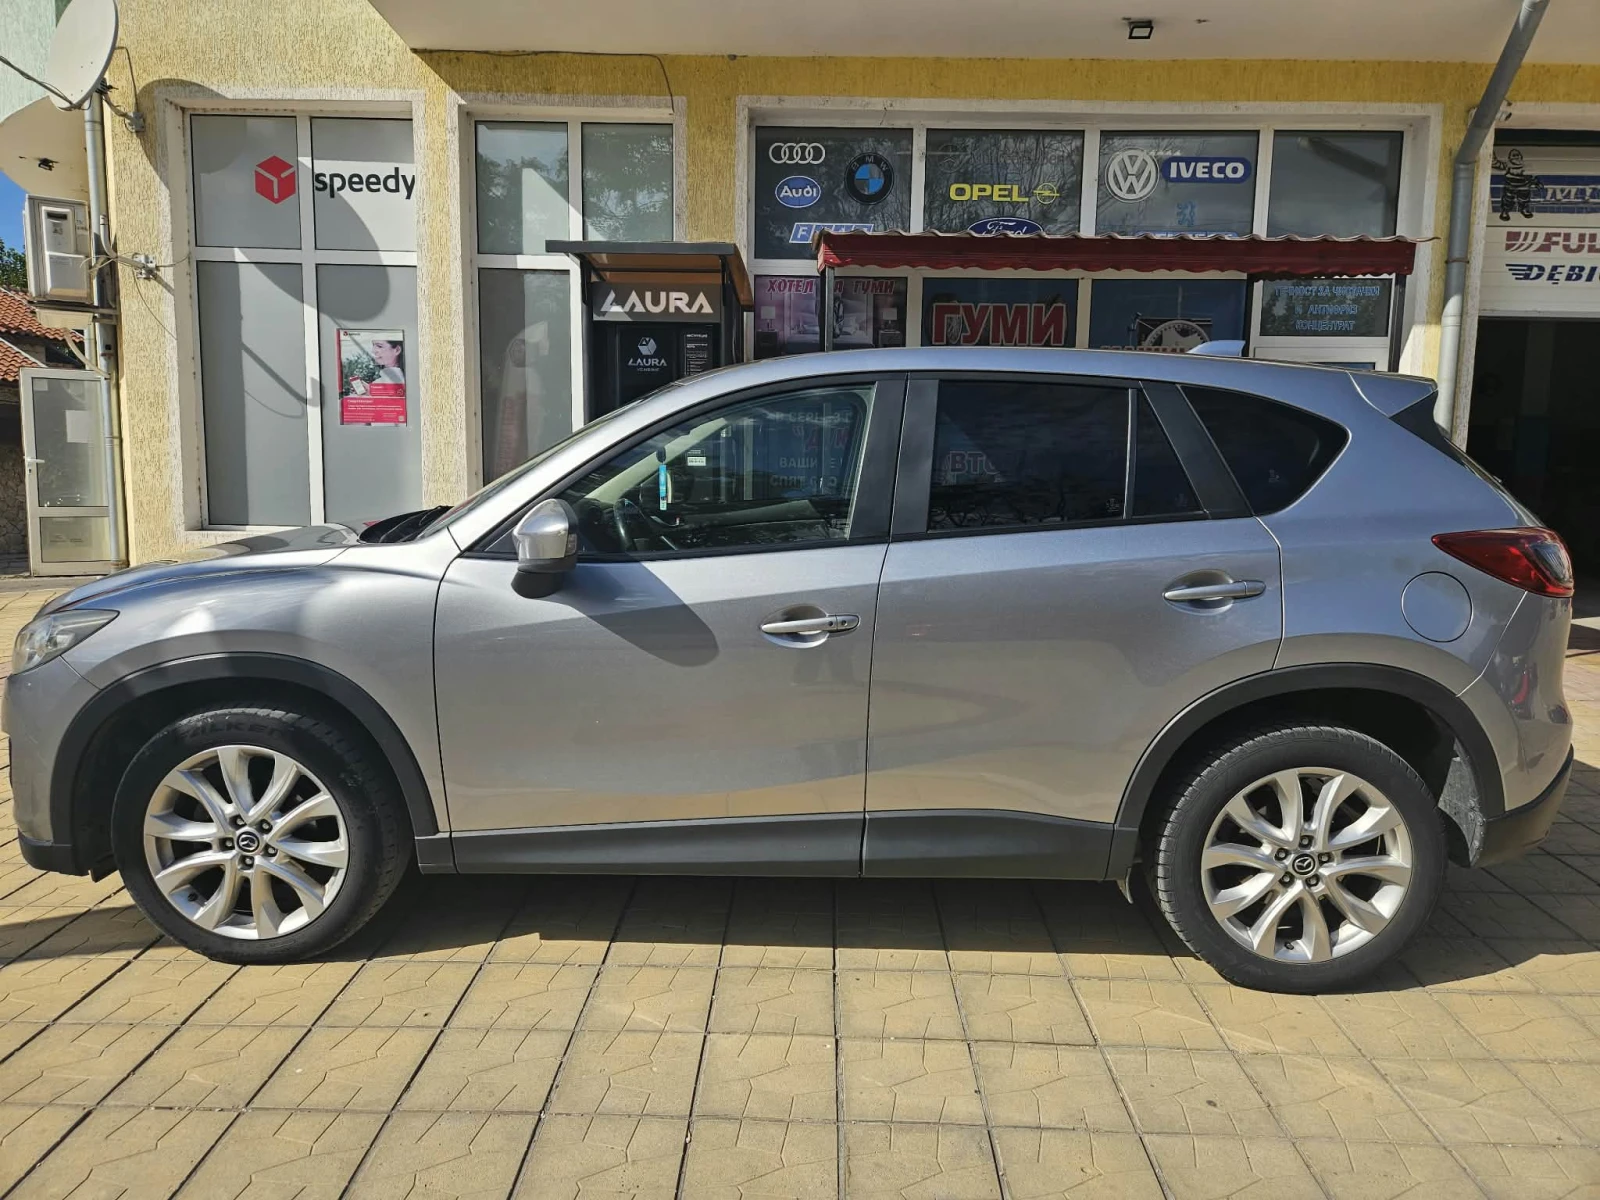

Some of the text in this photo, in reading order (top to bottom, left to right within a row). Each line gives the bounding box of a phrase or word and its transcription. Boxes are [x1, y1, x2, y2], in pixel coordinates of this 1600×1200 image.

[1170, 162, 1245, 178] IVECO
[314, 167, 416, 200] speedy
[779, 185, 817, 198] Audi
[950, 183, 1030, 202] OPEL
[767, 279, 815, 294] ХОТЕЛ
[854, 280, 895, 294] ГУМИ
[600, 289, 714, 313] LAURA
[931, 303, 1067, 346] ГУМИ
[628, 358, 668, 367] LAURA
